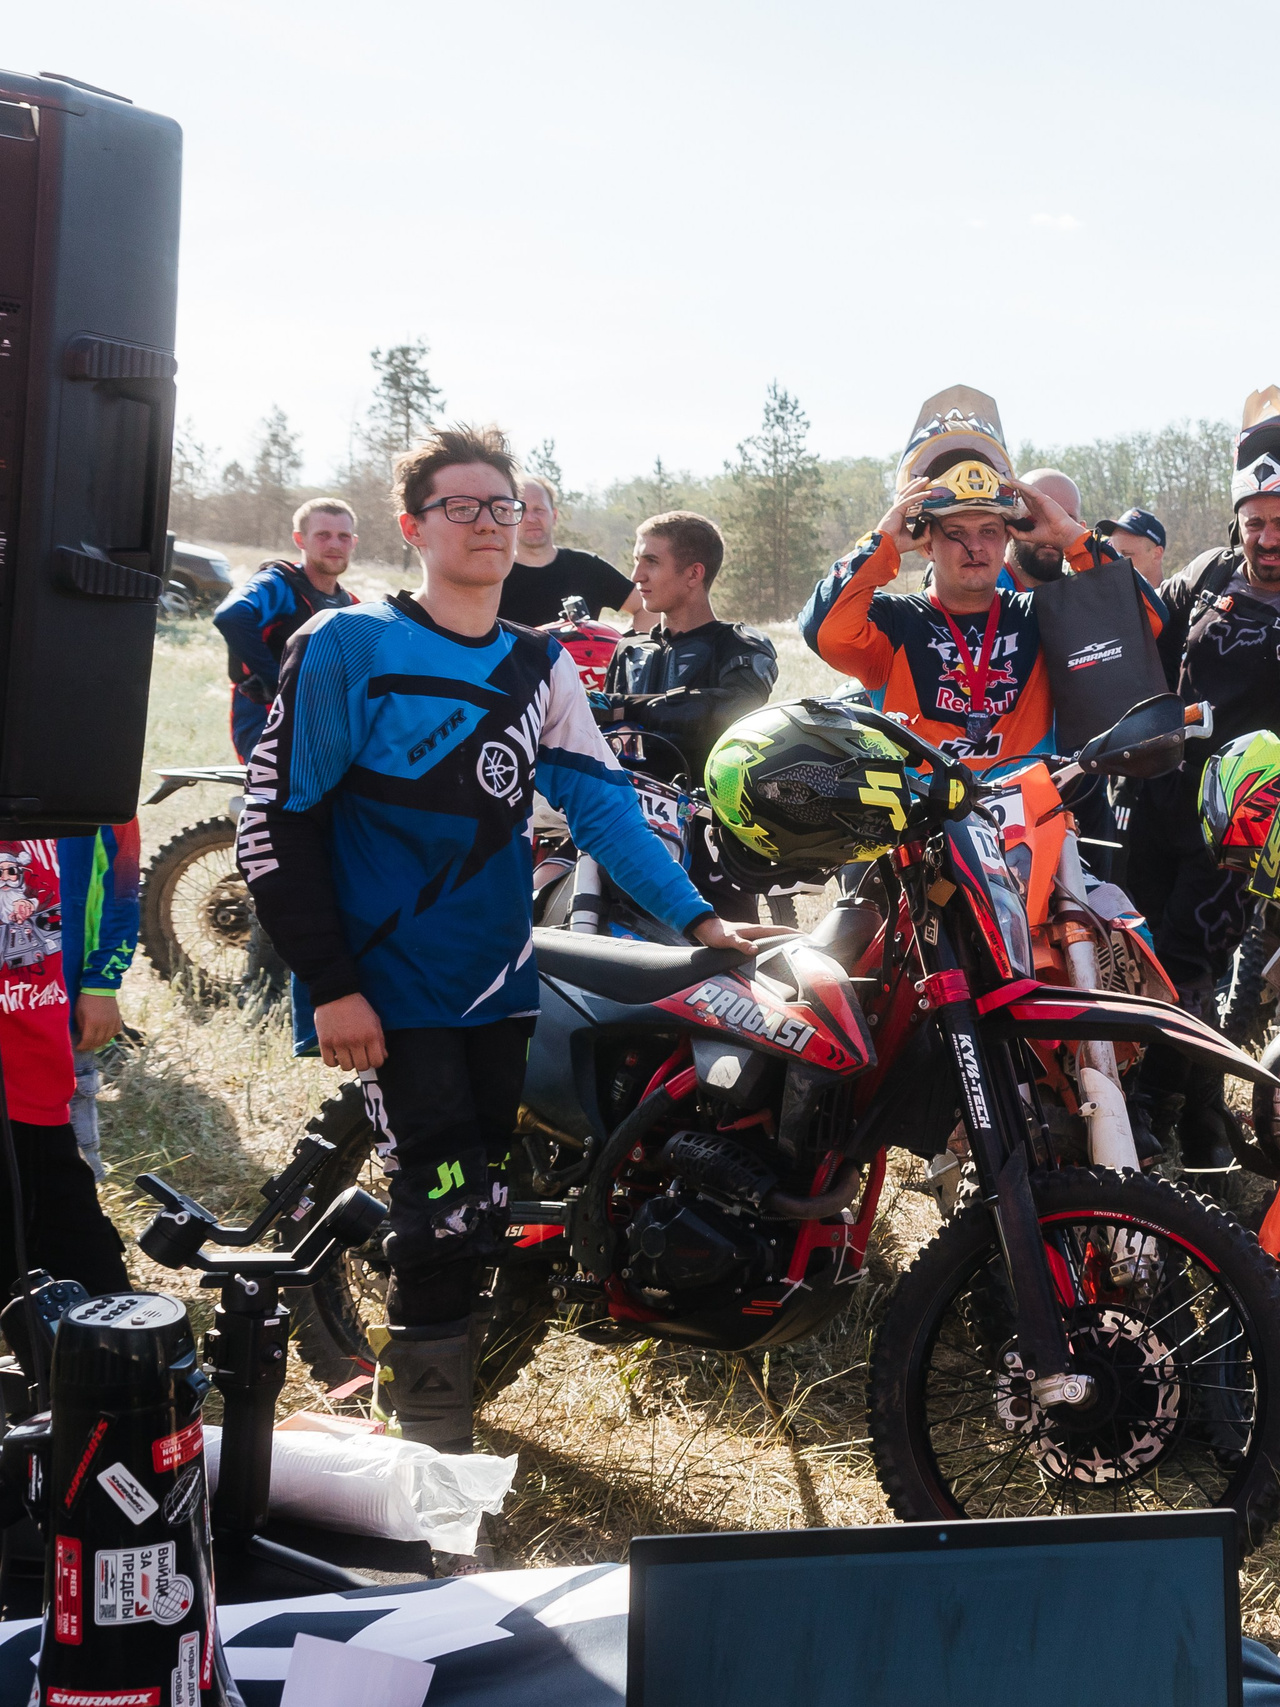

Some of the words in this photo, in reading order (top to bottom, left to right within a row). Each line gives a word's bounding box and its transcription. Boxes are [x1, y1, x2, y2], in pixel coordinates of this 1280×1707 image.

[1067, 646, 1123, 668] SHARMAX
[406, 708, 467, 766] GYTR
[238, 738, 280, 883] YAMAHA
[685, 982, 817, 1053] PROGASI
[120, 1553, 134, 1619] ПРЕДЕЛЫ
[140, 1550, 152, 1570] ЗА
[155, 1547, 171, 1598] ВЫЙДИ
[50, 1692, 153, 1706] SHARMAX
